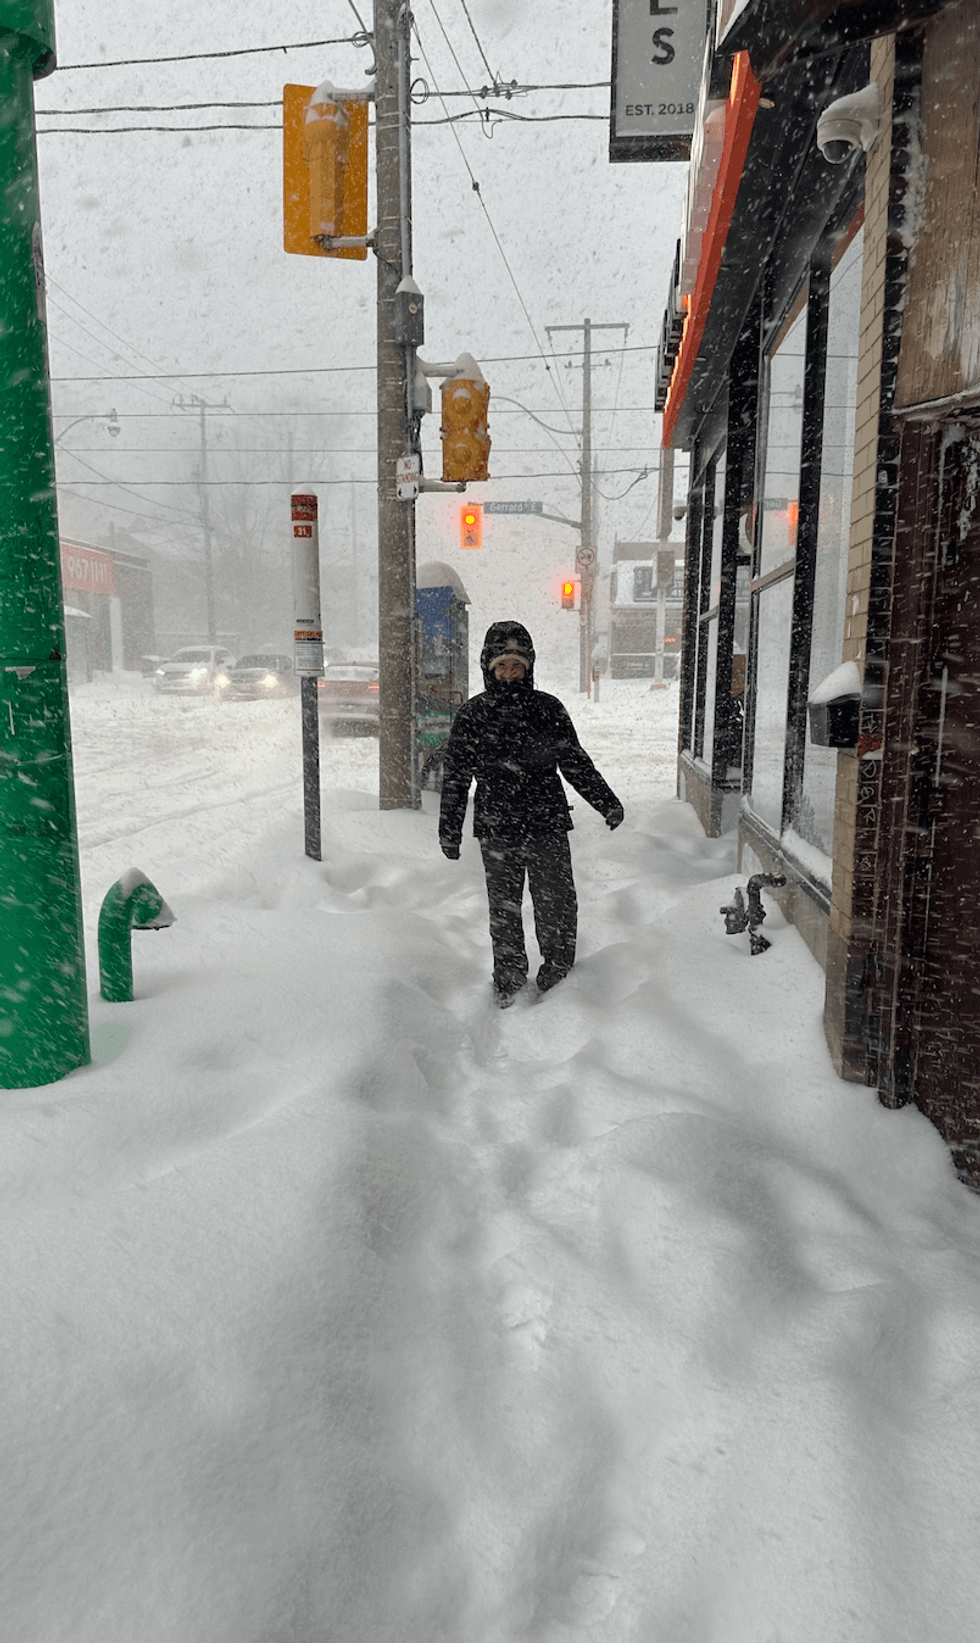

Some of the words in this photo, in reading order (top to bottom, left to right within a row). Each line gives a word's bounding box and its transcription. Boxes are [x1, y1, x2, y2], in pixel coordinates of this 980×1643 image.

[625, 104, 655, 116] EST.
[658, 102, 695, 115] 2018
[403, 460, 411, 470] NO
[489, 502, 523, 512] Gerrard
